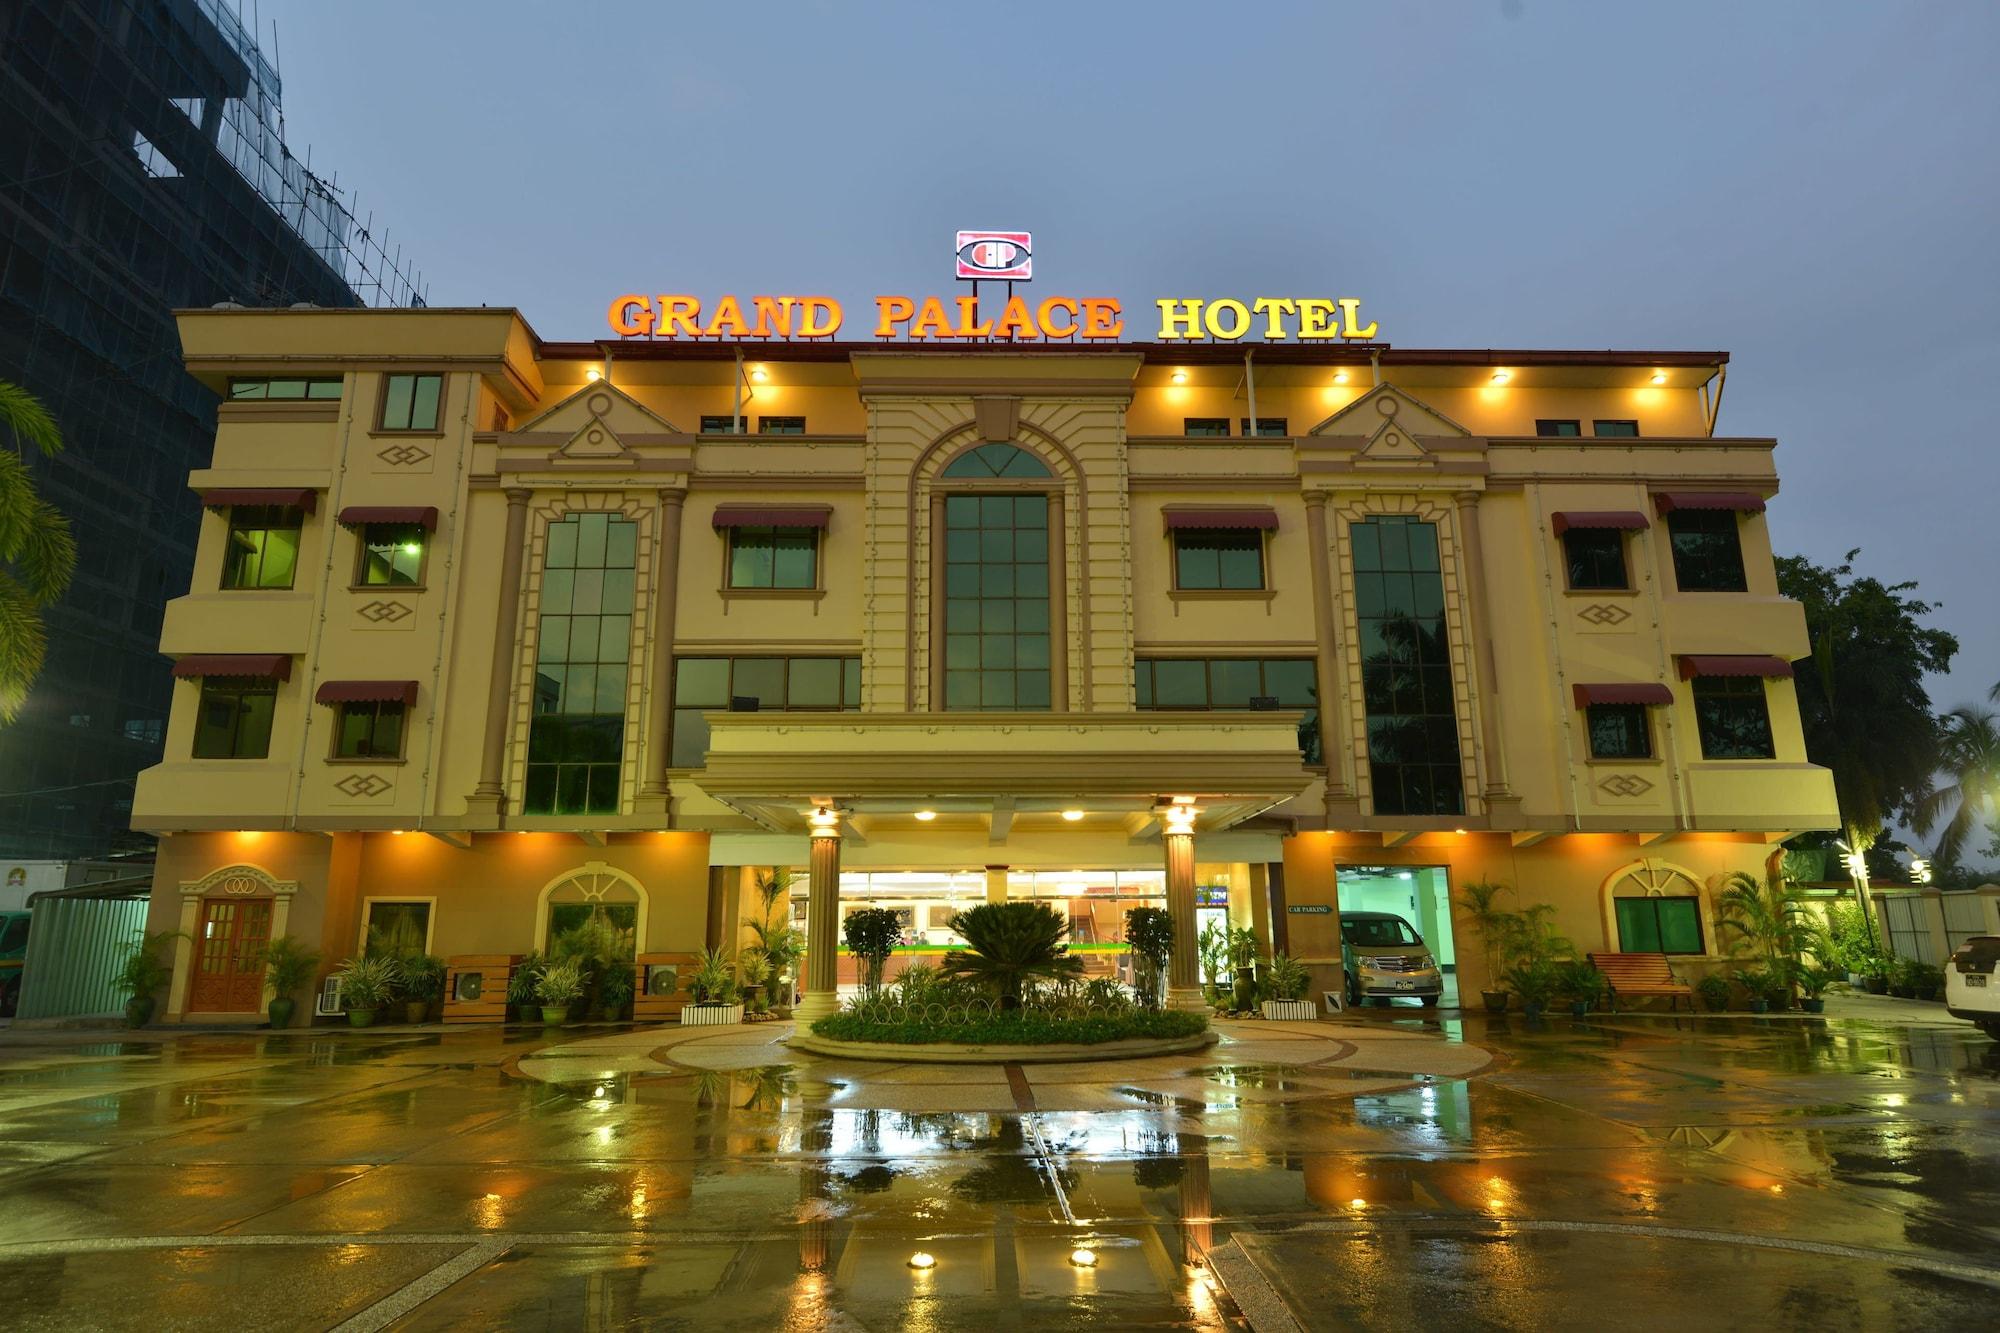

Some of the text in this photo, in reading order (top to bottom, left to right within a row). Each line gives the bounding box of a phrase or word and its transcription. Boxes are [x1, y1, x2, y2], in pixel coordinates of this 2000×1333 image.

[608, 295, 1378, 340] GRAND PALACE HOTEL
